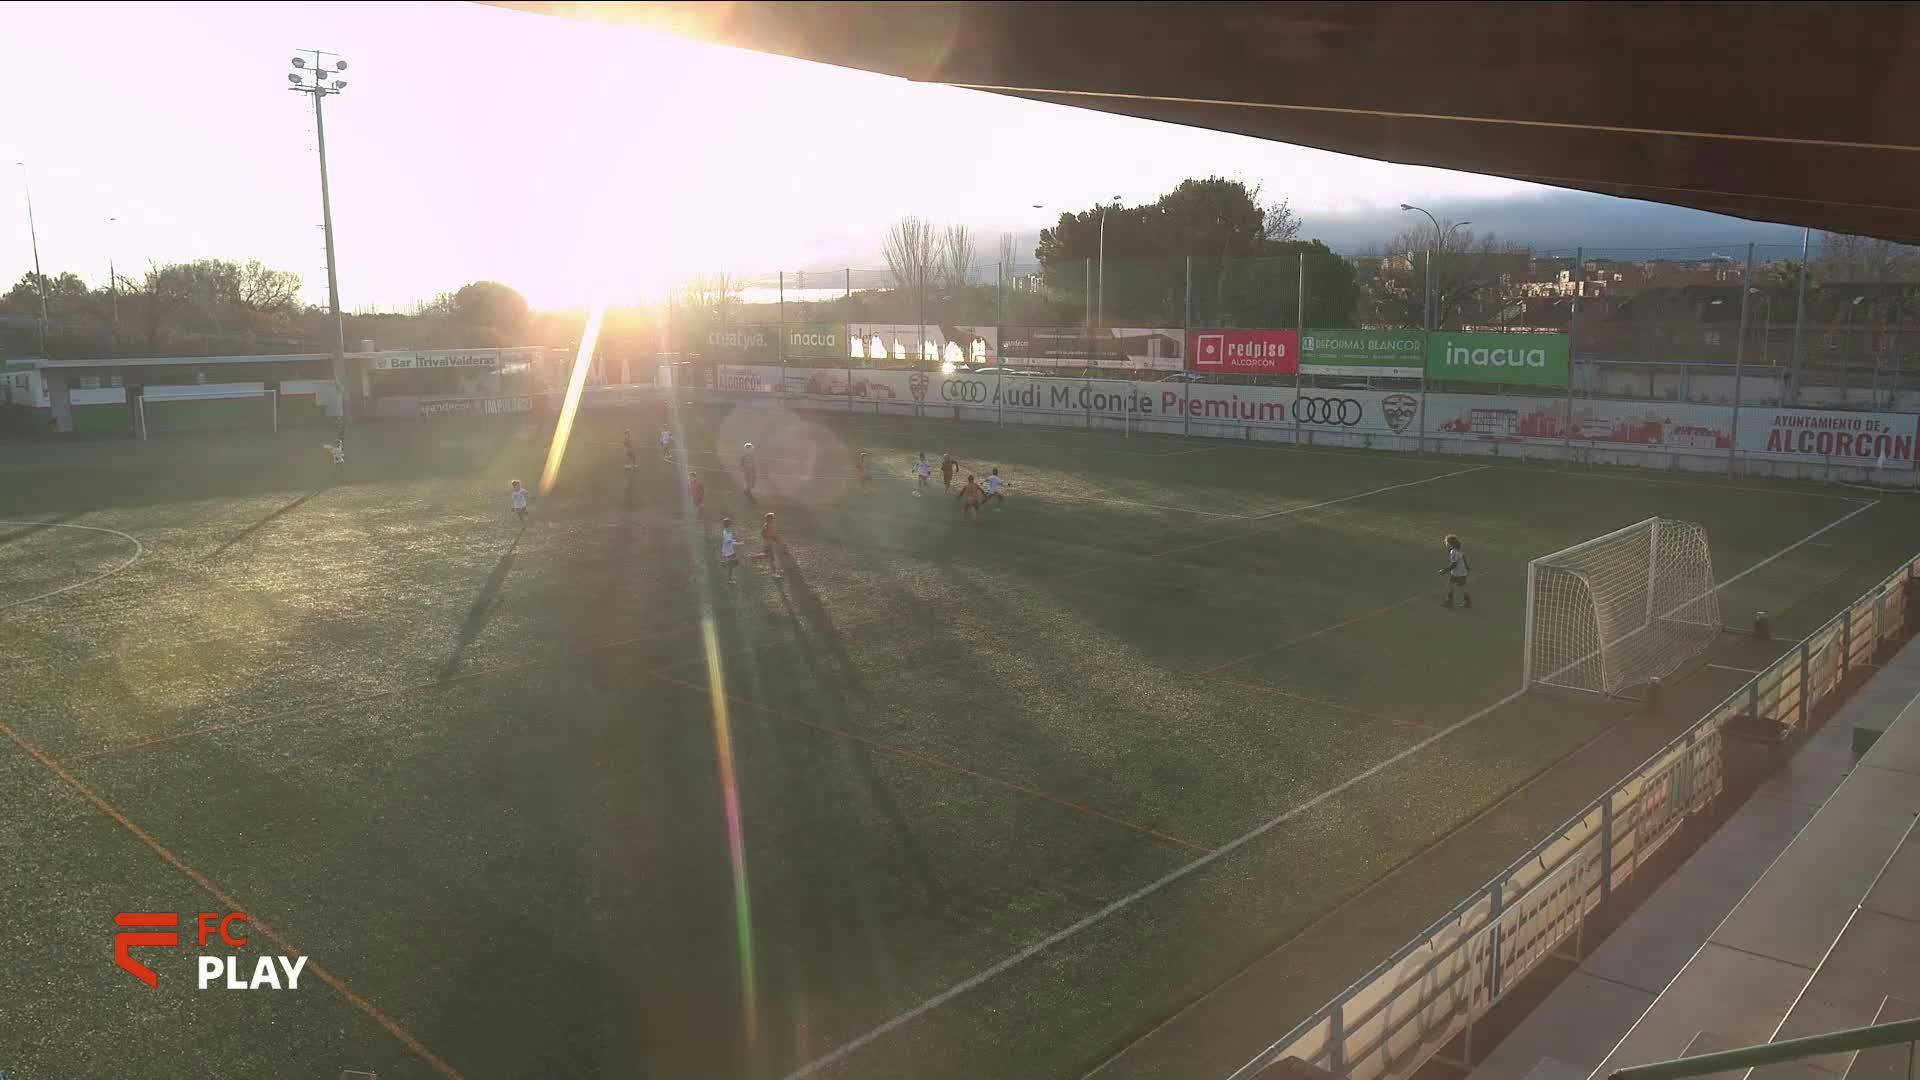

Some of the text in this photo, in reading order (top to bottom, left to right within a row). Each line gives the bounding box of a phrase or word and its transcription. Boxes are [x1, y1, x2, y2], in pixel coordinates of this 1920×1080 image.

[790, 331, 838, 347] inacua
[1228, 341, 1286, 358] redpiso
[1446, 341, 1545, 368] inacua
[391, 358, 413, 368] Bar
[992, 384, 1285, 421] Audi M.Conde Premium
[1774, 415, 1881, 432] AYUNTAMIENTO DE
[1766, 427, 1912, 460] ALCORCÓN
